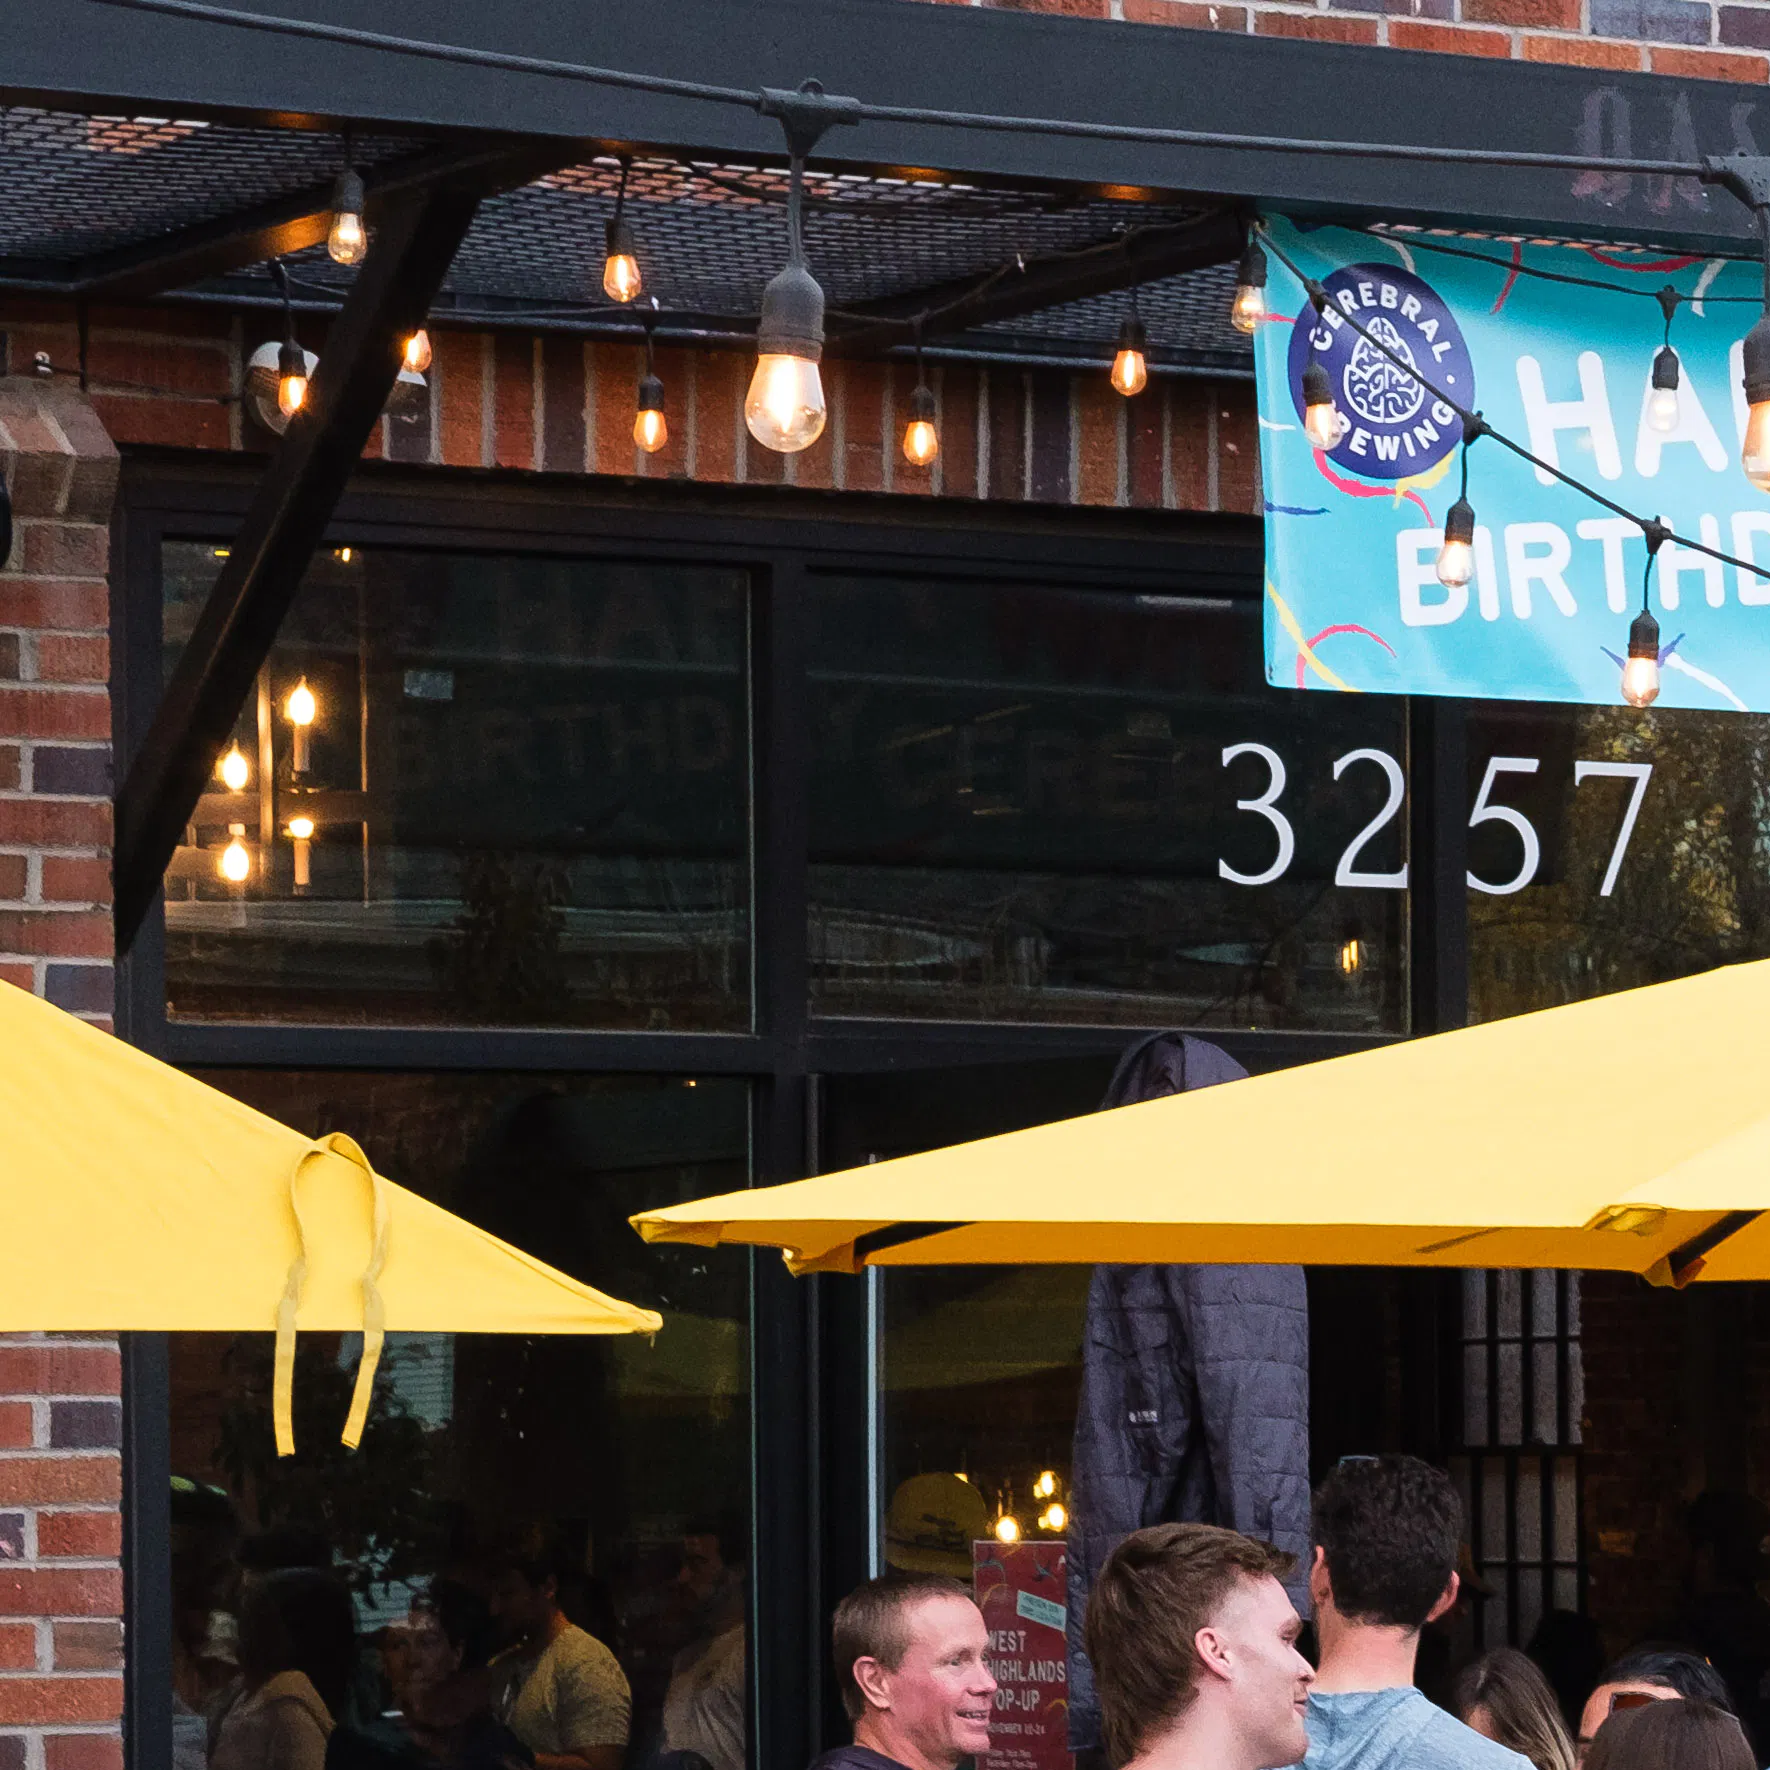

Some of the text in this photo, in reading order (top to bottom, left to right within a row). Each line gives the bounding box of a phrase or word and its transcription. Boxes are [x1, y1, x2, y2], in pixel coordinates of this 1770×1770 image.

[1309, 282, 1452, 363] CEREBRAL
[1218, 741, 1653, 897] 3257
[995, 1687, 1041, 1712] OP-UP
